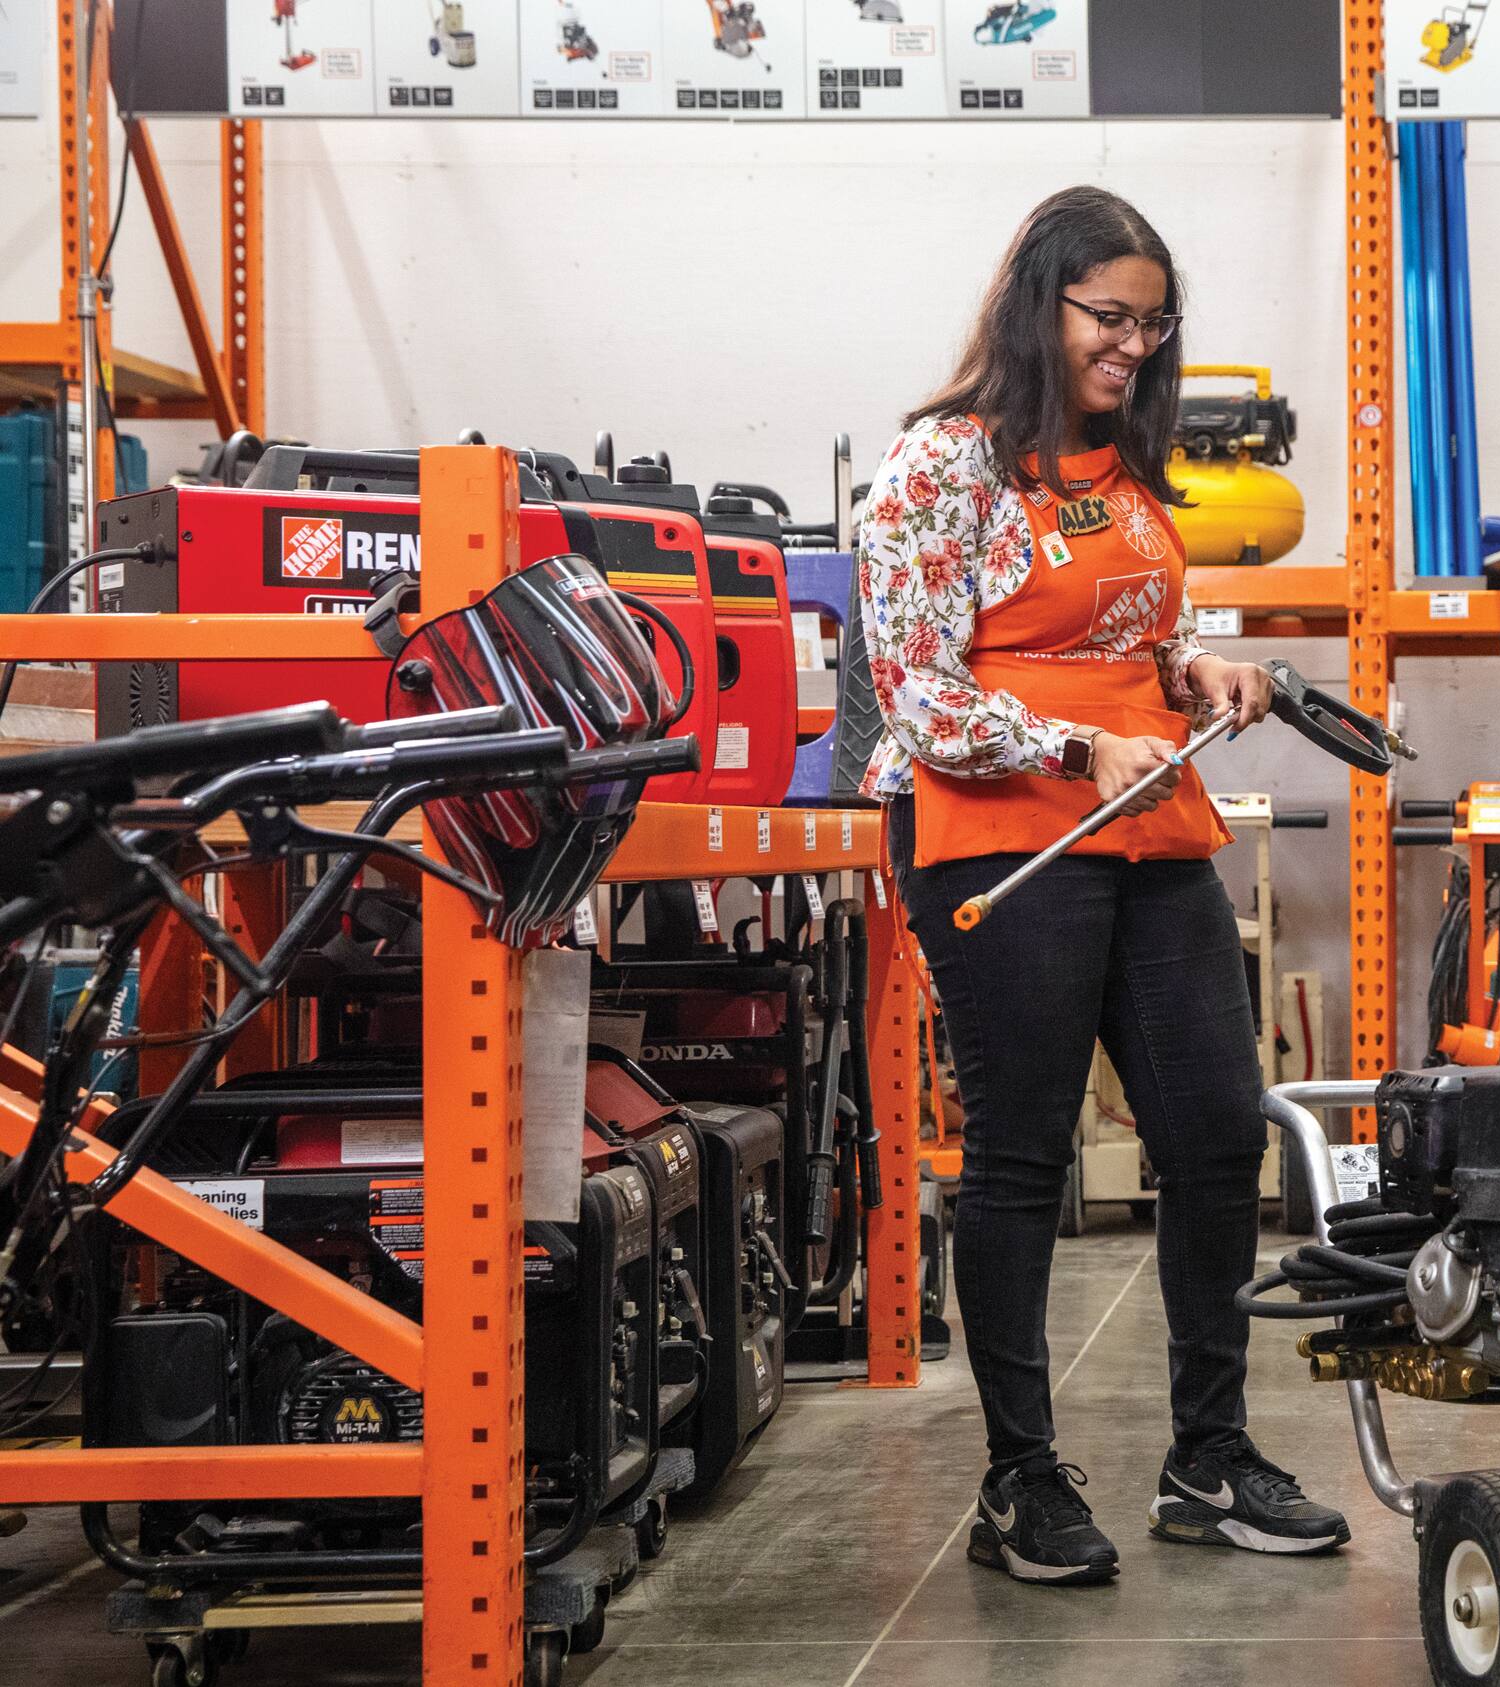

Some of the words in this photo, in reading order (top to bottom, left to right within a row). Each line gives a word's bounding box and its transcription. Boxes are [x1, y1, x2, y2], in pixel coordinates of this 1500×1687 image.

[1061, 498, 1110, 531] ALEX
[283, 519, 341, 577] HOME
[288, 524, 314, 548] THE
[305, 541, 342, 577] DEPOT
[1099, 587, 1134, 627] THE
[102, 985, 128, 1061] makia
[194, 1190, 247, 1206] aning
[223, 1207, 259, 1220] lies
[336, 1422, 380, 1435] Mi-T-M
